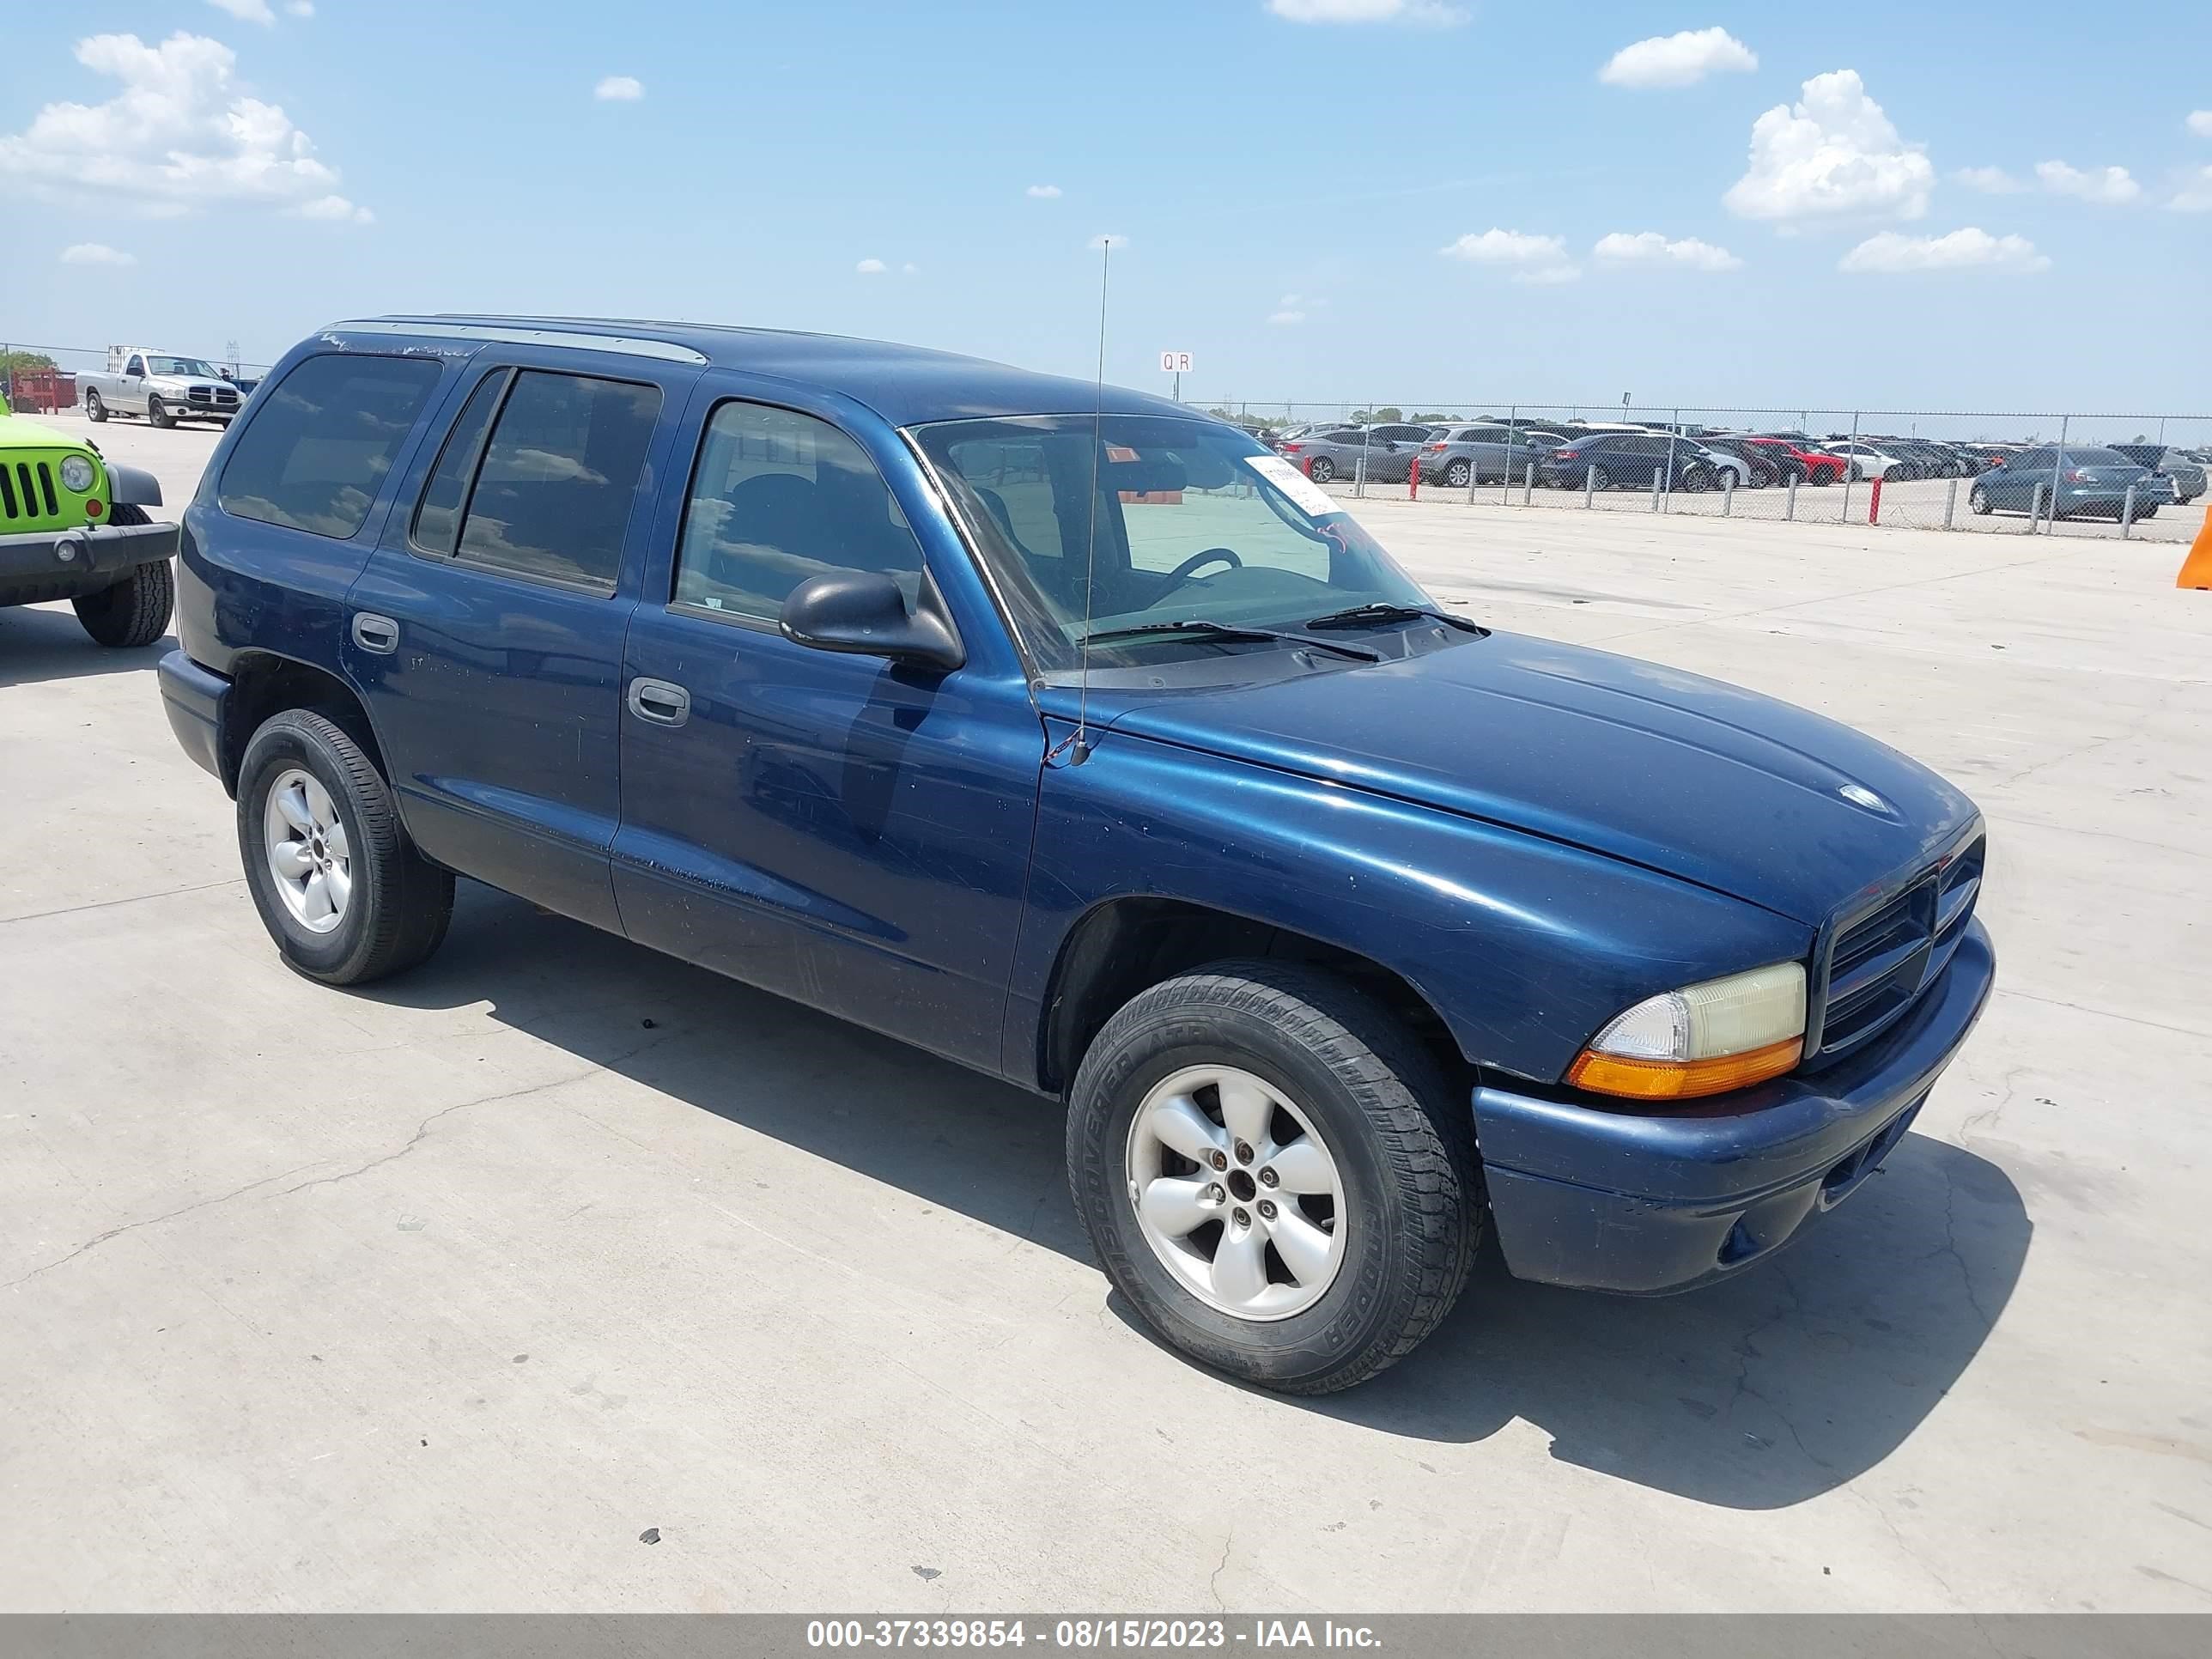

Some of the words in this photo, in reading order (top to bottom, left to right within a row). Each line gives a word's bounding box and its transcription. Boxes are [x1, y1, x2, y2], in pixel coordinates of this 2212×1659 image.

[1164, 354, 1173, 370] Q
[1180, 354, 1188, 370] R
[1084, 1050, 1146, 1288] DISCOVERER
[1322, 1200, 1384, 1352] COOPER
